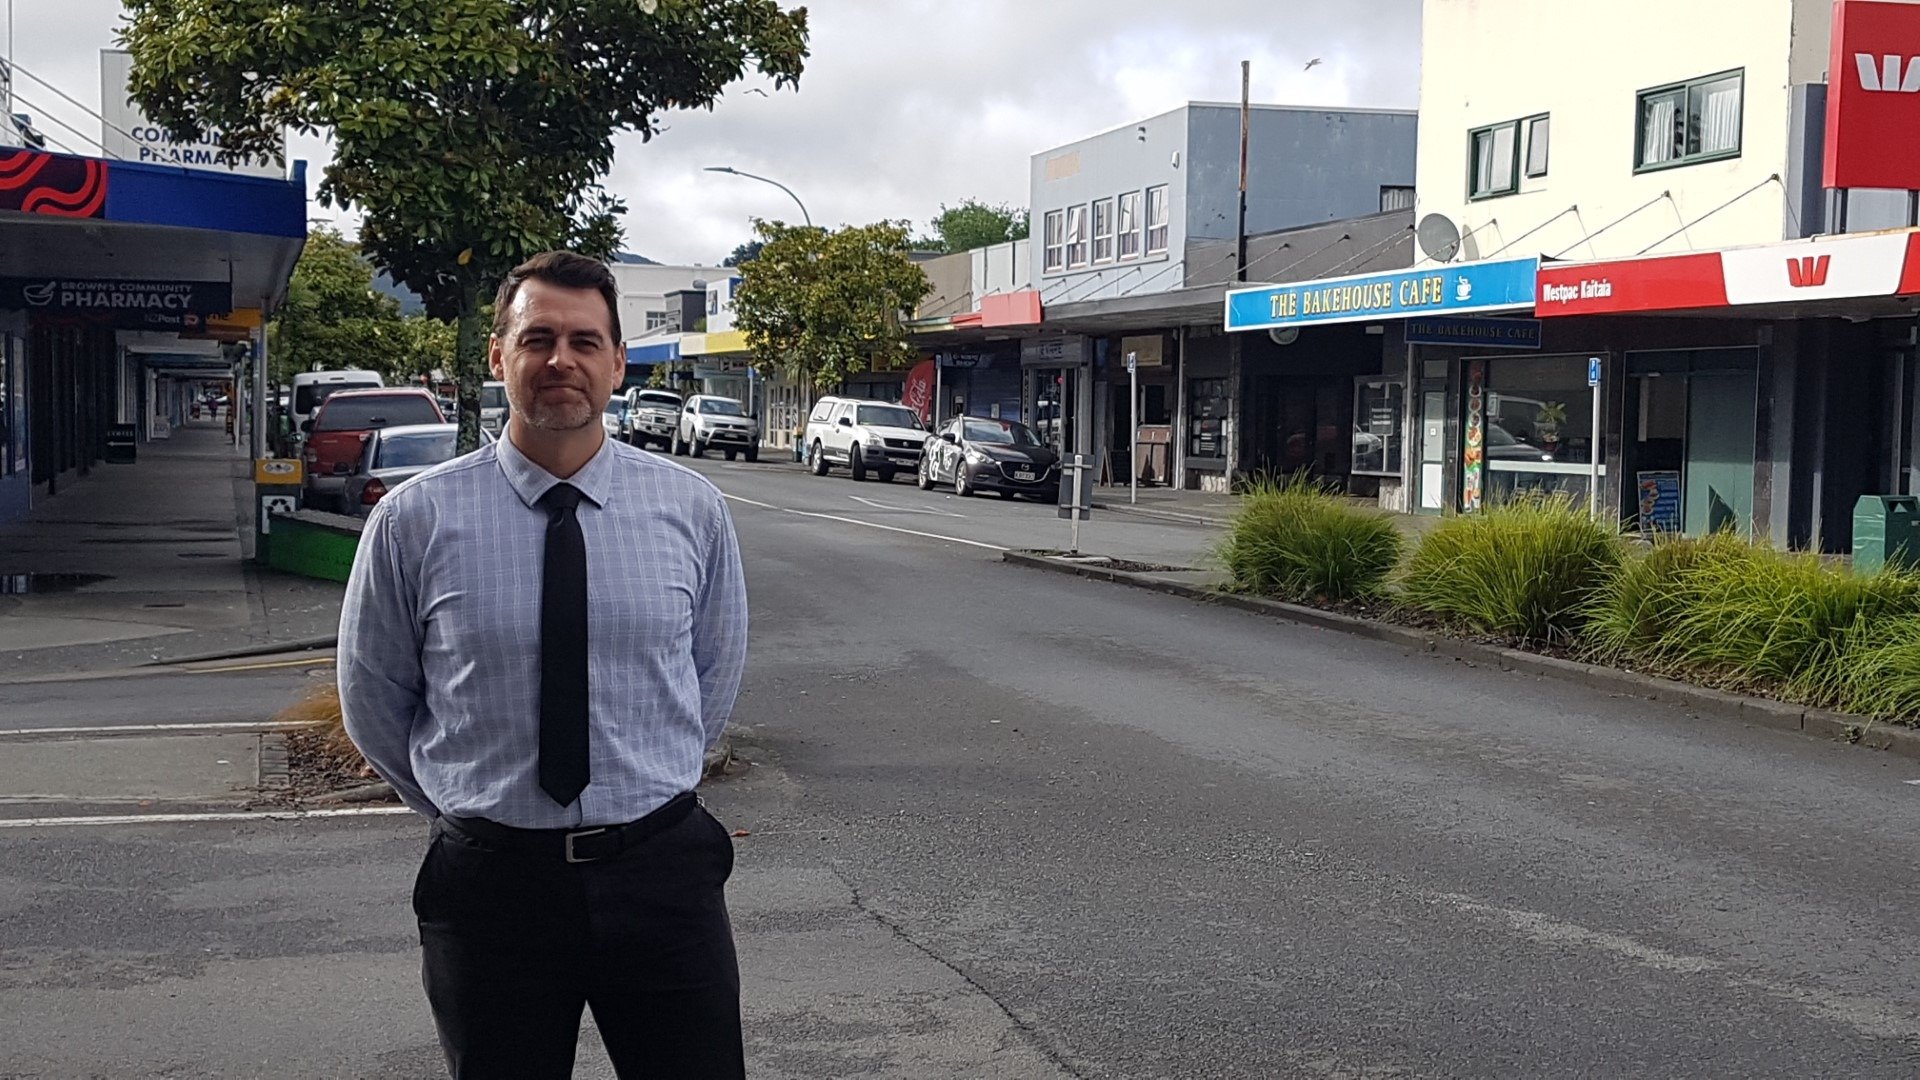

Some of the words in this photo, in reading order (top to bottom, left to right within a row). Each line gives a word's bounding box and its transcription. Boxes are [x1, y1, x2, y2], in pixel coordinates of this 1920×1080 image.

[119, 283, 192, 293] COMMUNITY
[1270, 295, 1296, 318] THE
[1303, 283, 1392, 315] BAKEHOUSE
[1400, 276, 1443, 306] CAFE
[1543, 284, 1578, 304] Westpac
[1581, 279, 1611, 299] Kaitaia
[61, 291, 192, 309] PHARMACY
[1411, 323, 1433, 335] THE
[1438, 324, 1503, 338] BAKEHOUSE
[1507, 327, 1536, 340] CAFE
